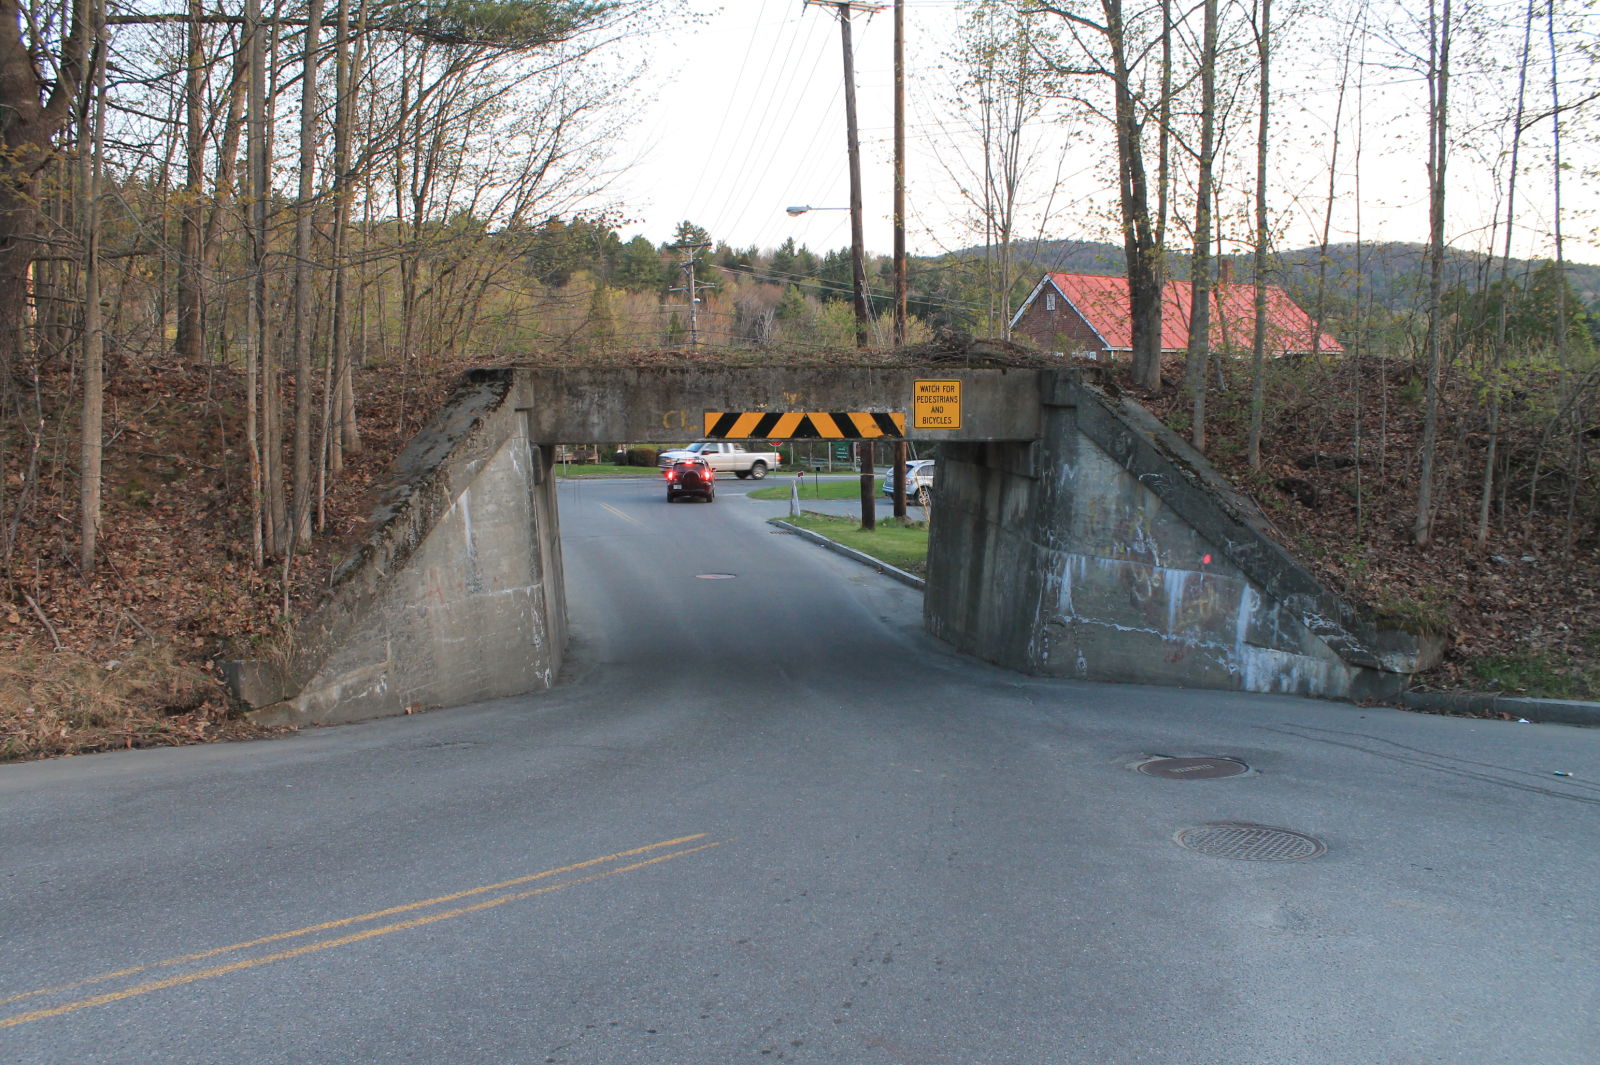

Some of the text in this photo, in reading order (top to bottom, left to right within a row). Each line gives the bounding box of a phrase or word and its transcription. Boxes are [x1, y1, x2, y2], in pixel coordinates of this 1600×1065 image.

[920, 385, 955, 393] WATCH FOR
[916, 395, 958, 403] PEDESTRIANS
[922, 416, 952, 424] BICYCLES
